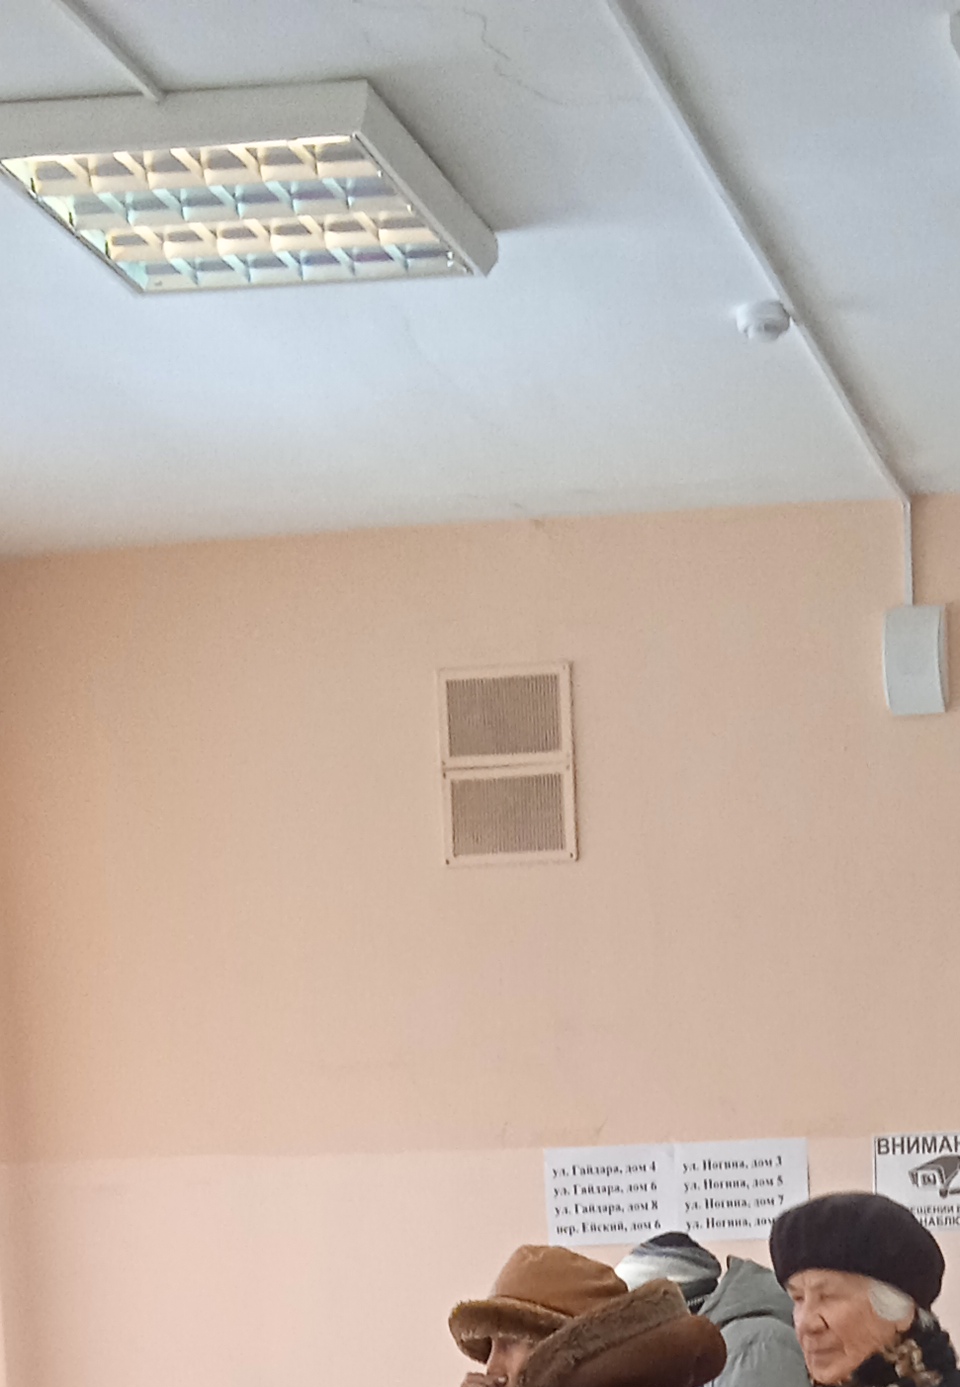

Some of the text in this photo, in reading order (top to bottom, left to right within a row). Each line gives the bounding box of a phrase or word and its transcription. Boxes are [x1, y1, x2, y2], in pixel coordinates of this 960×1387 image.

[571, 1164, 623, 1177] Гайдара,
[649, 1160, 656, 1173] 4
[573, 1183, 624, 1197] Гайдара,
[574, 1202, 625, 1216] Гайдара,
